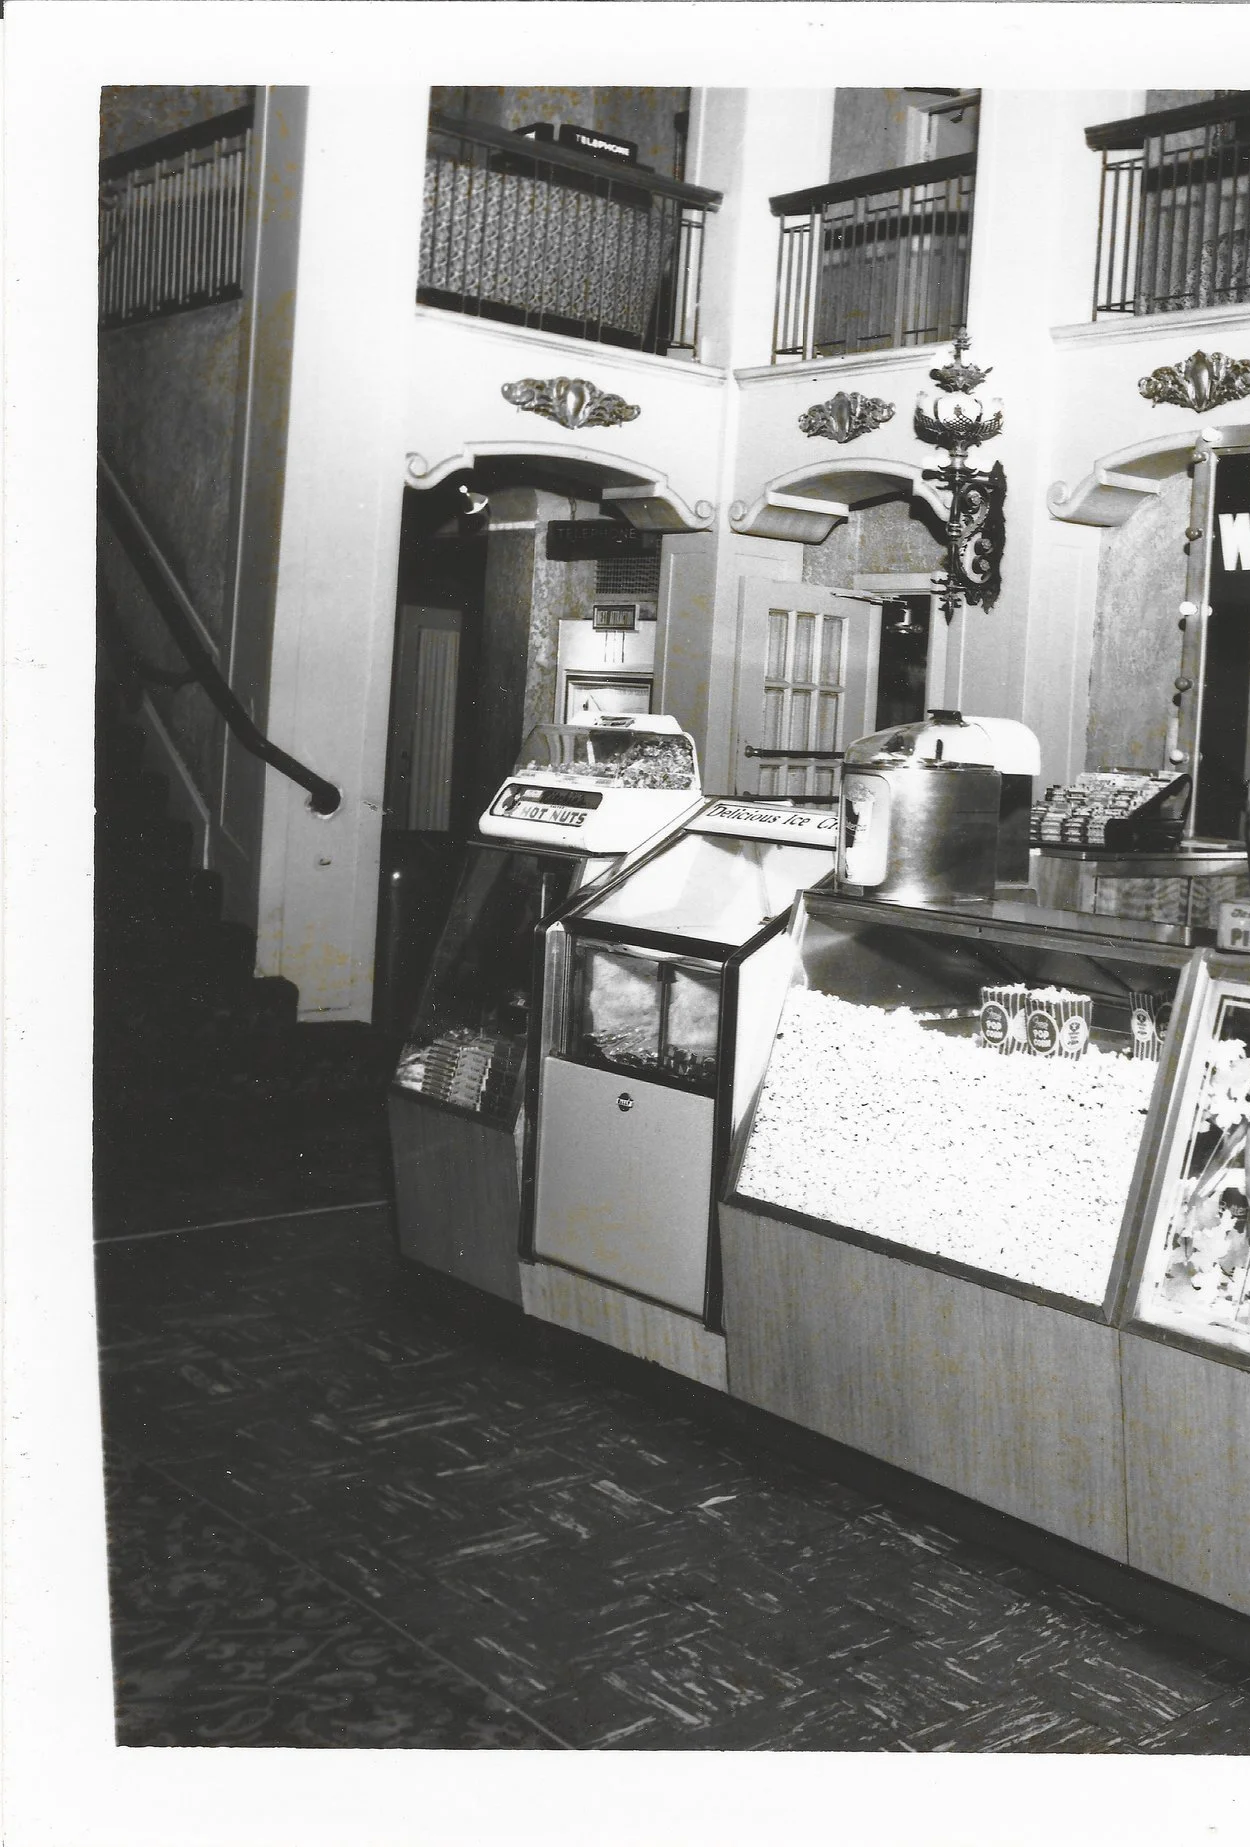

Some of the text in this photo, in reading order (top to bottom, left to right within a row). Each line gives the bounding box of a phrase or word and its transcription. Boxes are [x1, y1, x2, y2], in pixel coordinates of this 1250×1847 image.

[521, 806, 588, 825] HOT NUTS
[706, 804, 781, 824] Delicious
[782, 814, 811, 827] Ice
